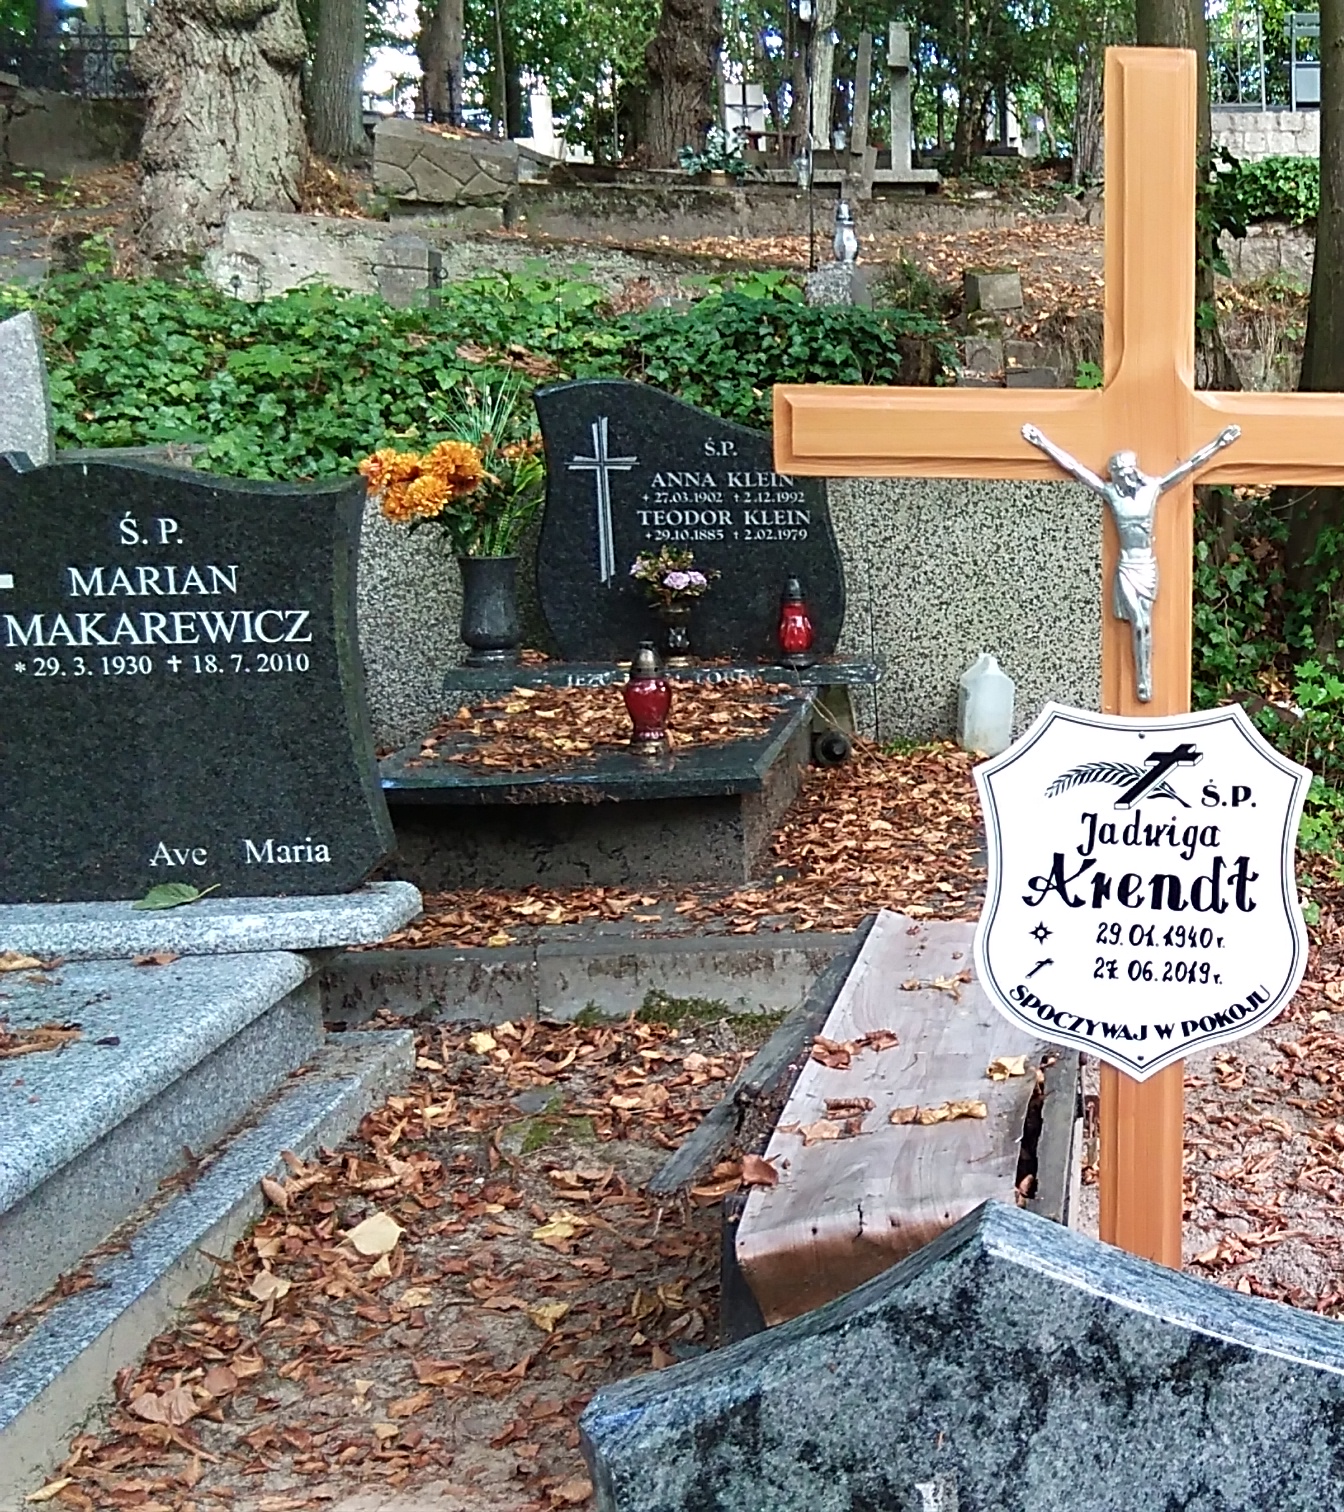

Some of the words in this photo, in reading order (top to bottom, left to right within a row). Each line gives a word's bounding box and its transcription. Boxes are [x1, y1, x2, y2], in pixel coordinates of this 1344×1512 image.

[651, 471, 717, 488] ANNA
[727, 471, 795, 488] KLEIN
[636, 509, 733, 526] TEODOR
[744, 509, 811, 526] KLEIN
[68, 565, 239, 597] MARIAN
[4, 609, 313, 647] MAKAREWICZ
[1201, 778, 1257, 808] Ś.P.
[1077, 809, 1221, 861] Jadwiga
[150, 841, 208, 867] Ave
[242, 836, 332, 864] Maria
[1021, 852, 1260, 914] Arendt
[1009, 984, 1148, 1042] SPOCZYWAJ
[1153, 1023, 1177, 1041] W
[1180, 984, 1271, 1038] POKOJU
